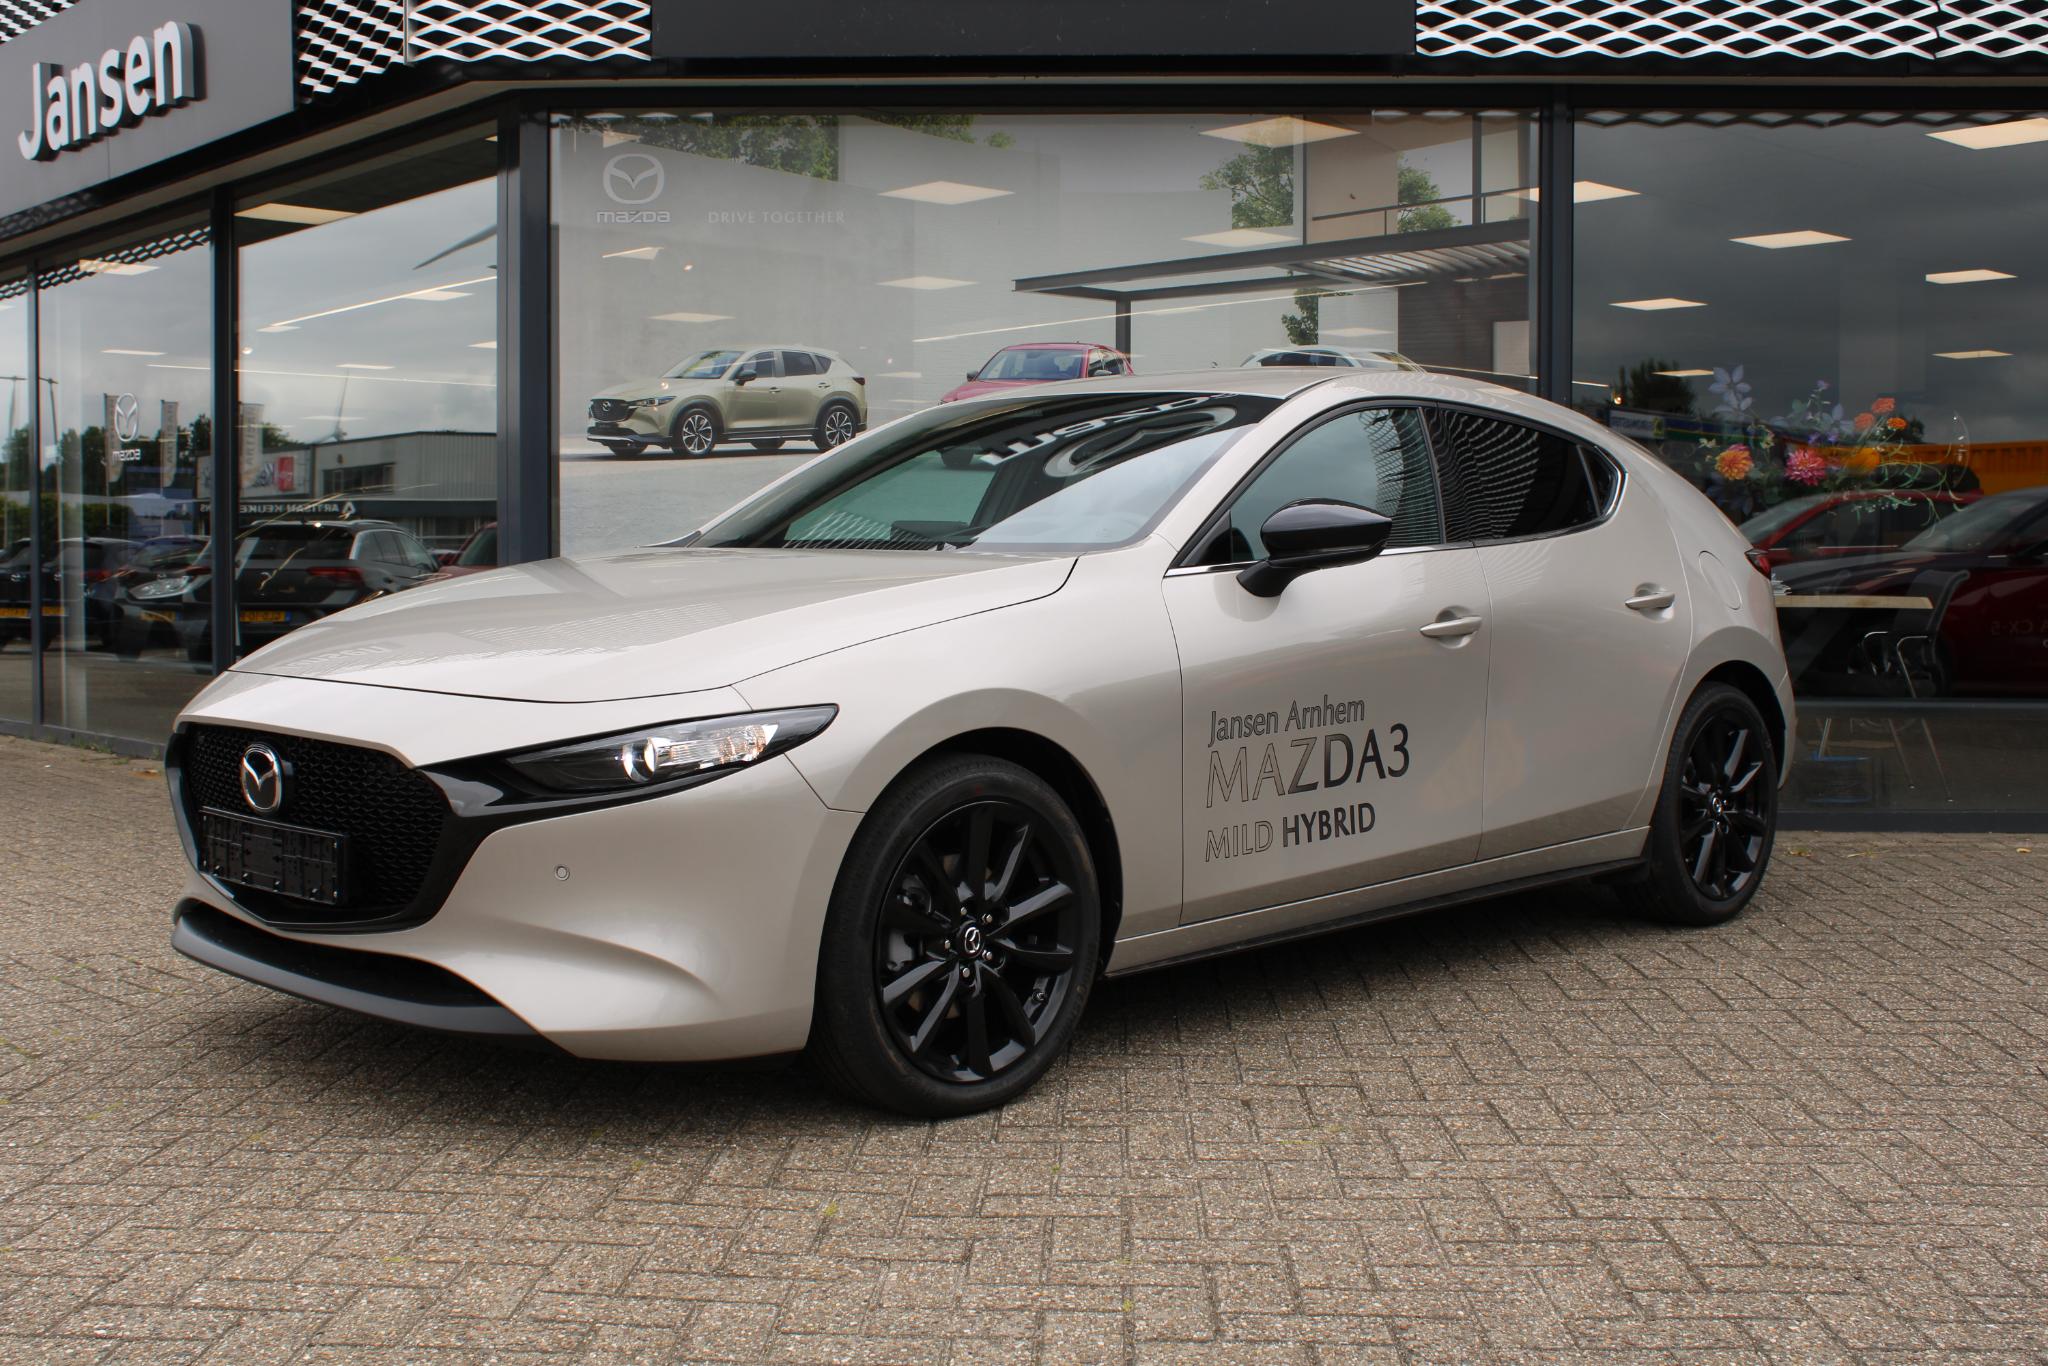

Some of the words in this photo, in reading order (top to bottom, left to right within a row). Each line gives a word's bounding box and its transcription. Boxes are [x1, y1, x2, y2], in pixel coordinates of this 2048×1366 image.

[18, 20, 194, 160] Jansen
[596, 210, 671, 224] mazda
[708, 211, 755, 224] DRIVE
[762, 211, 847, 224] TOGETHER
[112, 449, 141, 464] mazda
[1208, 710, 1279, 748] Jansen
[1285, 694, 1365, 732] Arnhem
[1206, 723, 1410, 808] MAZDA3
[1205, 820, 1274, 862] MILD
[1282, 802, 1376, 848] HYBRID
